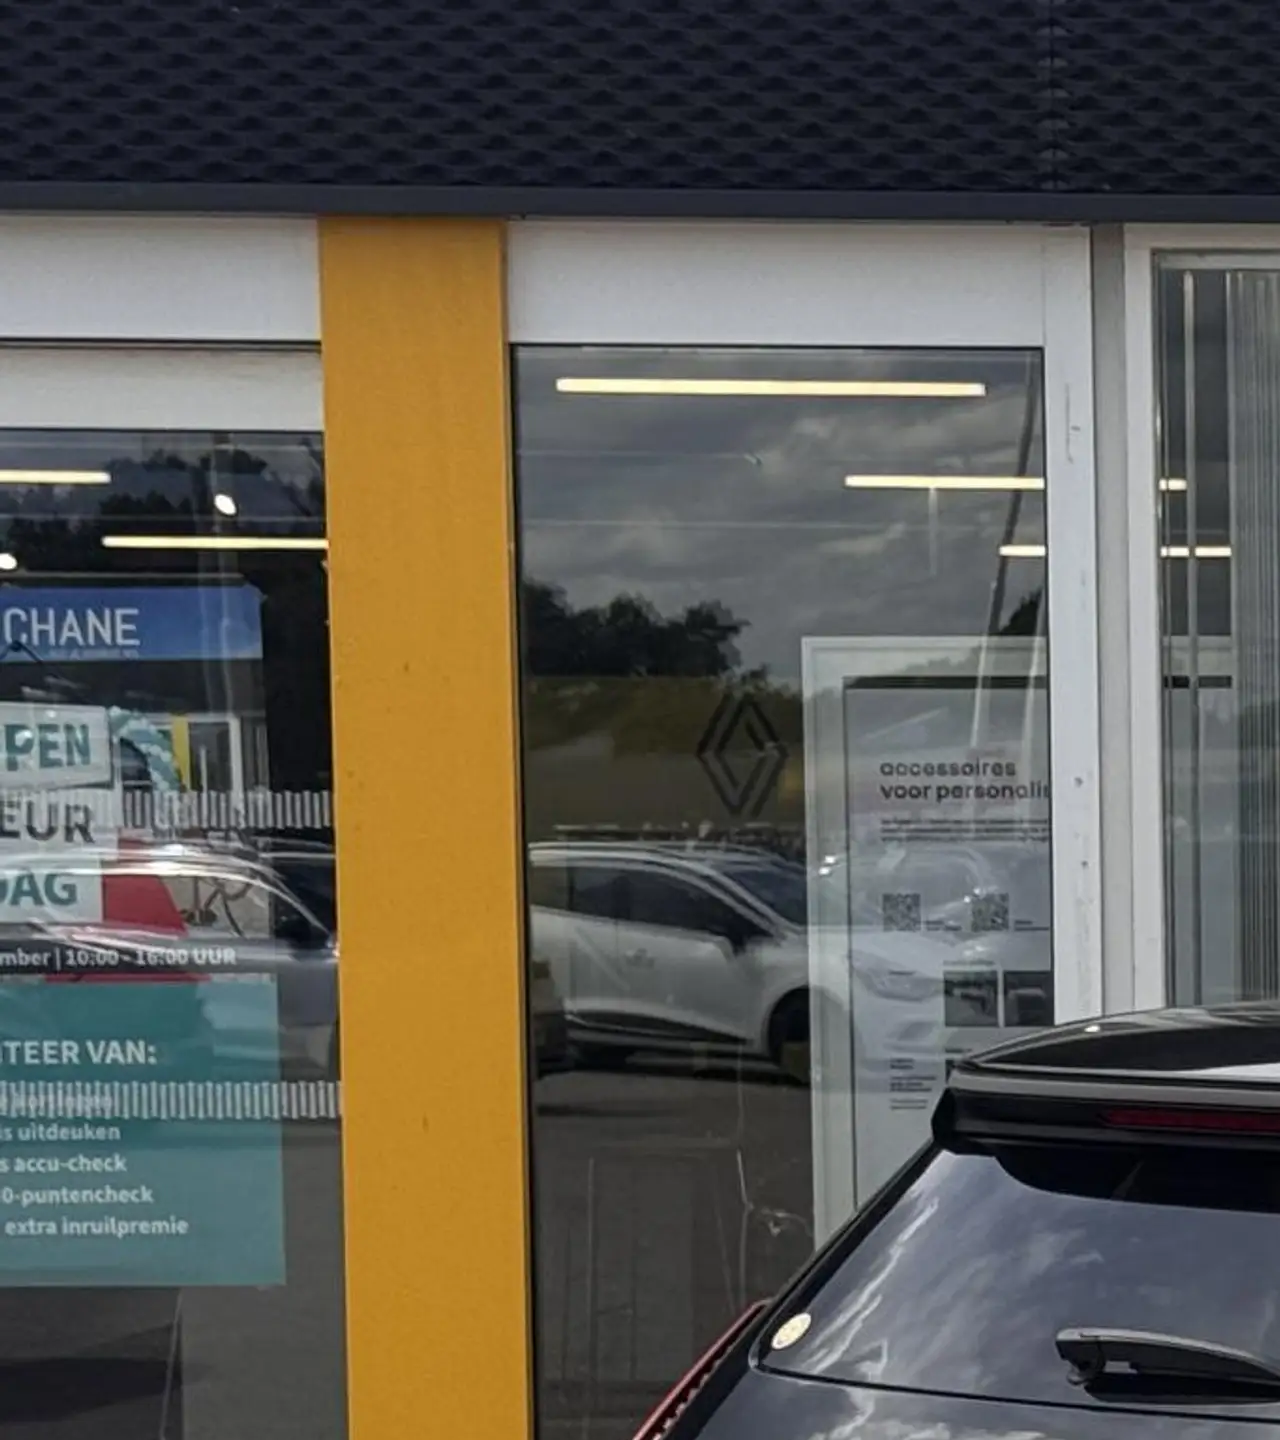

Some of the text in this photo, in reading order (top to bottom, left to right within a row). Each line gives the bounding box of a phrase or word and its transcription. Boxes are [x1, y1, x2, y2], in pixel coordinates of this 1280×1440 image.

[3, 607, 141, 647] CHANE
[4, 723, 91, 771] PEN
[880, 757, 1016, 777] accessoires
[880, 783, 930, 800] voor
[0, 800, 96, 843] EUR
[192, 947, 237, 966] UUR
[0, 1040, 157, 1065] TEER VAN:
[17, 1122, 121, 1141] uitdeuken
[13, 1152, 127, 1173] accu-check
[2, 1185, 155, 1208] 0-puntencheck
[4, 1215, 190, 1240] extra inruilpremie
